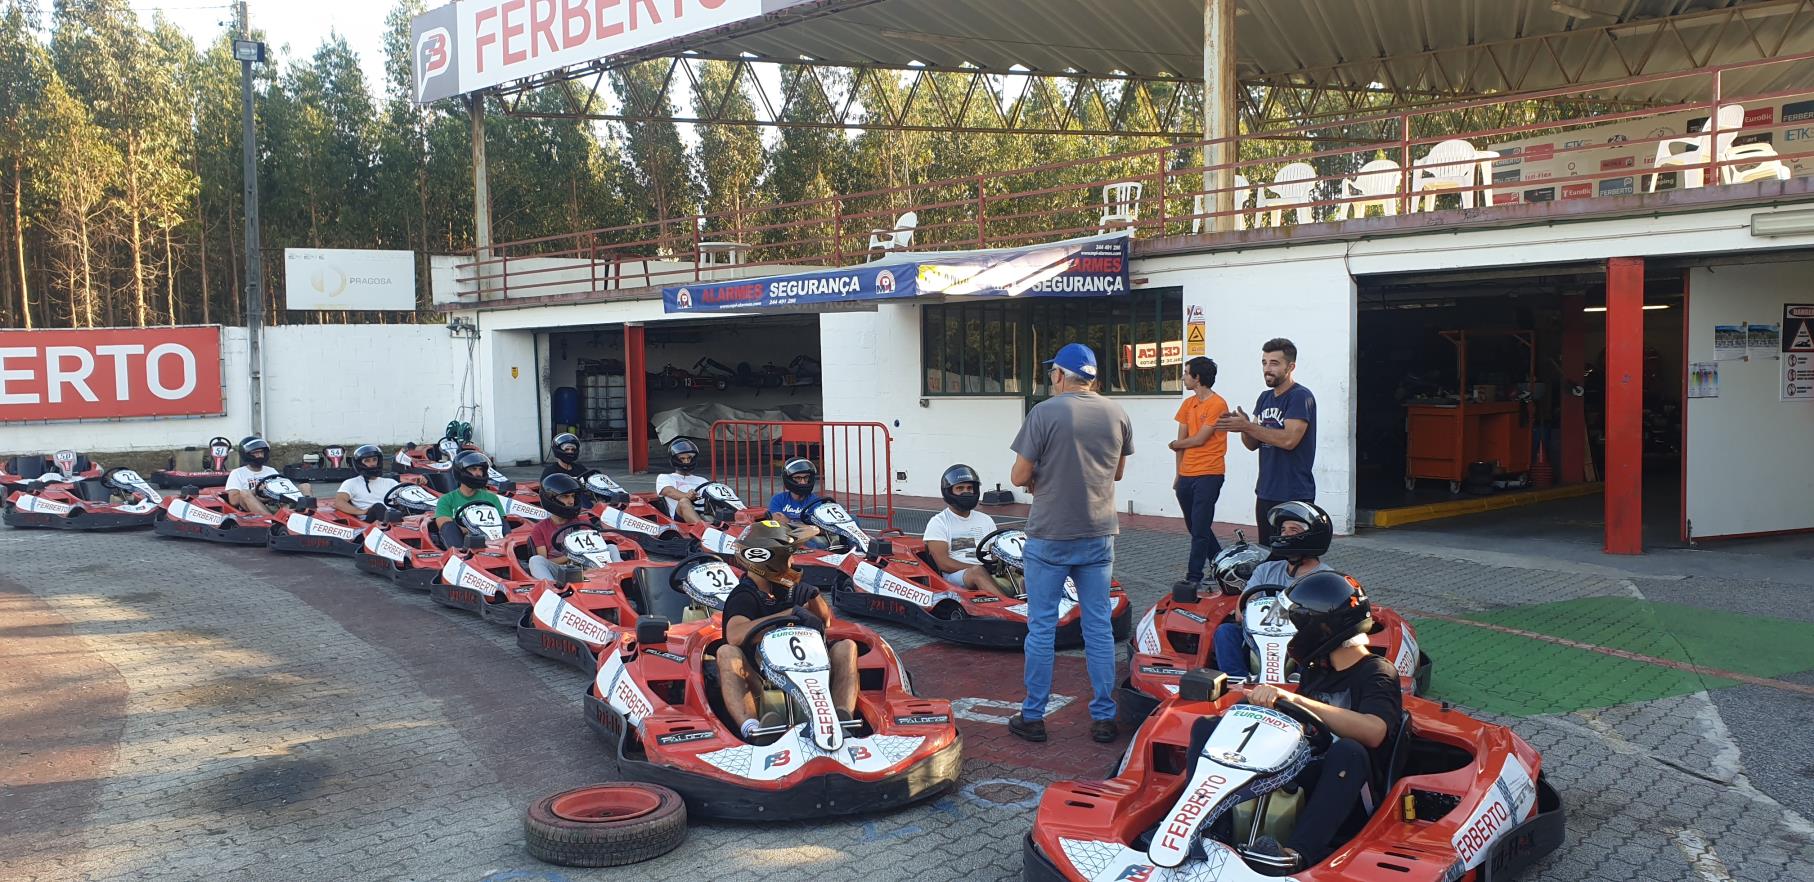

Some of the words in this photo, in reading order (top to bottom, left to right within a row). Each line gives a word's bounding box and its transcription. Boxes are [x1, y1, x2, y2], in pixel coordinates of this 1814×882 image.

[475, 0, 727, 74] FERBE
[1744, 113, 1773, 123] EuroBic
[702, 284, 764, 303] ALARMES
[769, 276, 861, 298] SEGURANÇA
[1032, 276, 1124, 297] SEGURANÇA
[329, 449, 341, 457] 54
[122, 472, 140, 482] 22
[279, 481, 290, 492] 5
[410, 488, 429, 500] 11
[715, 486, 732, 497] 29
[36, 501, 70, 514] FERBERTO
[188, 508, 222, 526] FERBERTO
[475, 509, 495, 523] 24
[512, 502, 546, 519] FERBERTO
[826, 507, 845, 520] 15
[312, 523, 352, 540] FERBERTO
[622, 517, 659, 536] FERBERTO
[574, 534, 596, 549] 14
[463, 572, 497, 596] FERBERTO
[706, 569, 734, 588] 32
[882, 578, 931, 607] FERBERTO
[560, 611, 607, 644] FERBERTO
[771, 630, 814, 639] EUROINDY
[789, 636, 806, 661] 6
[1266, 642, 1281, 684] ERBERTO
[615, 680, 653, 719] FERBERT
[803, 678, 834, 735] FERBERTO
[1233, 710, 1290, 730] EUROINDY
[1235, 721, 1260, 754] 1
[1161, 774, 1227, 851] FERBERTO
[1455, 801, 1507, 864] ERBERTO
